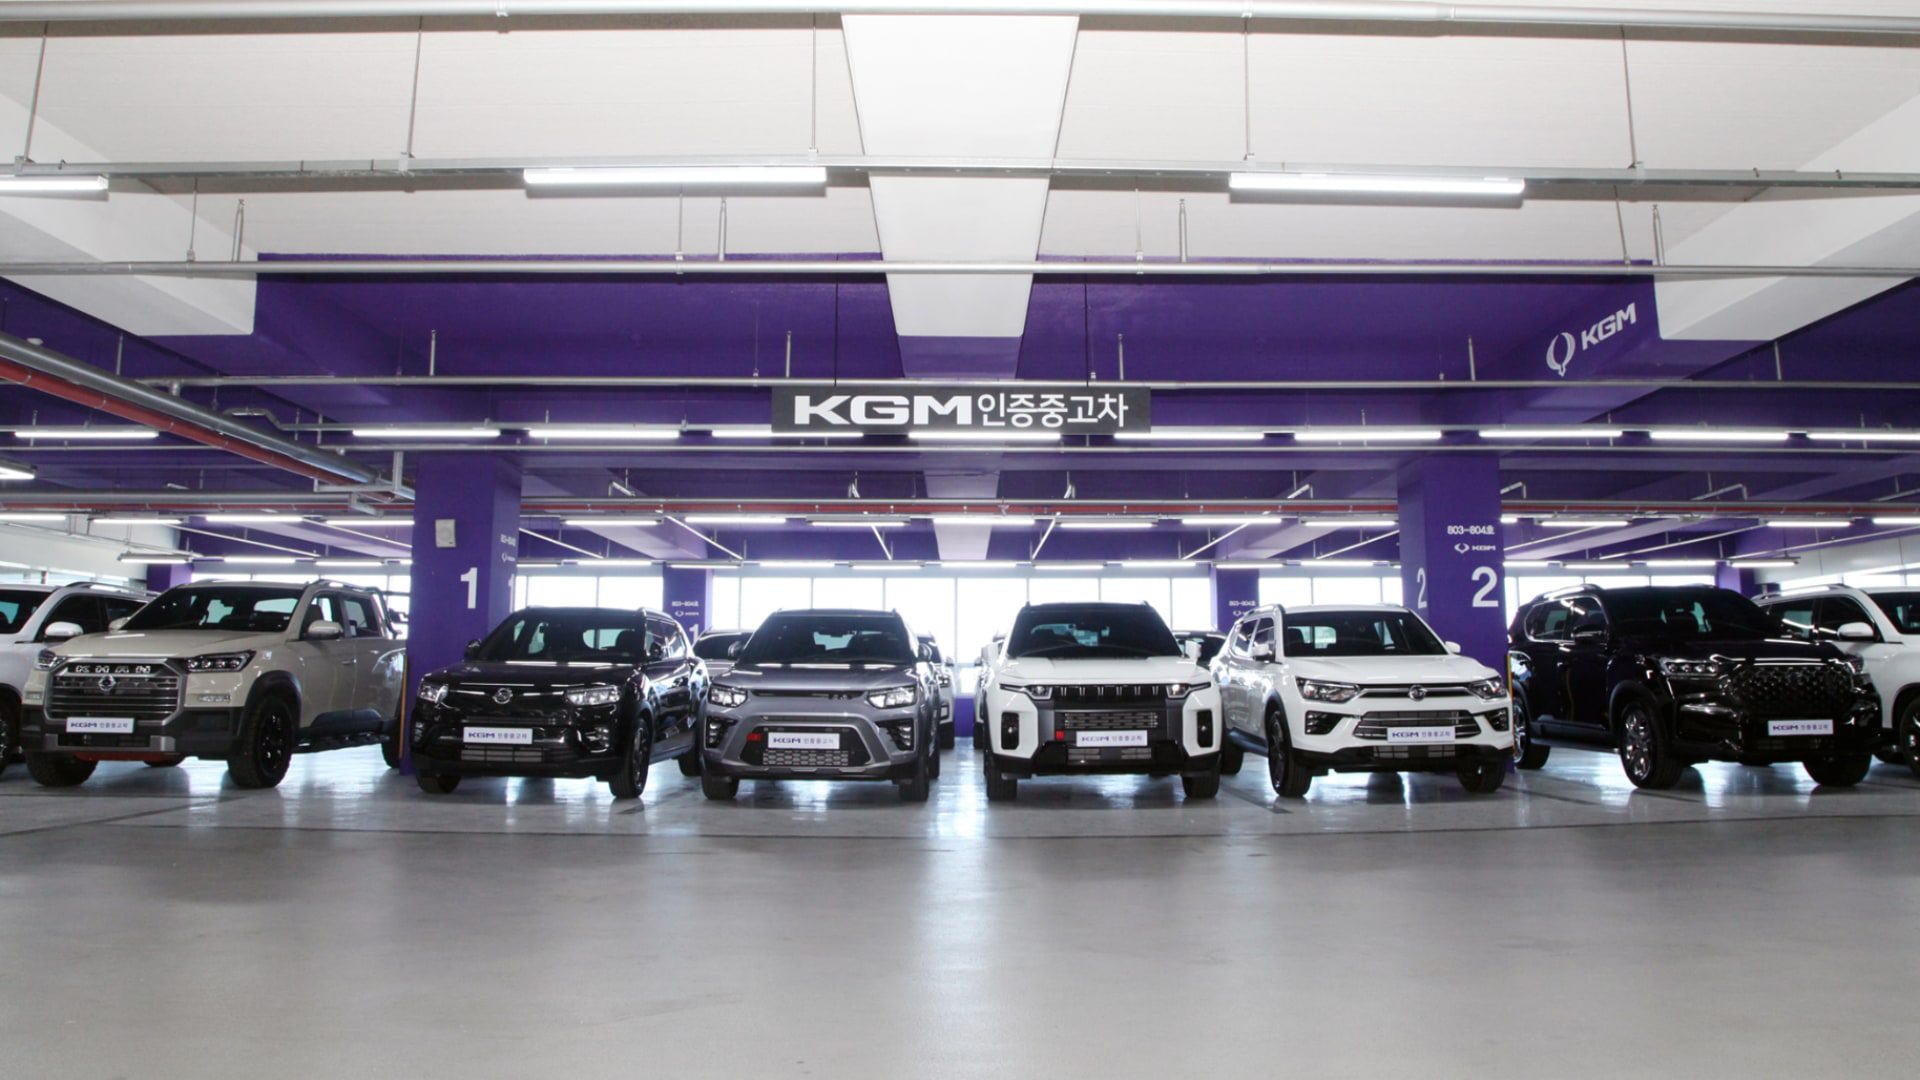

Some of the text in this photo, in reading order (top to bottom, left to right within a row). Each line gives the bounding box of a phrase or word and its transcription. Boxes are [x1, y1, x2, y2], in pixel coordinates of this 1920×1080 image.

[1581, 302, 1637, 351] KGM
[794, 393, 1129, 428] KGM 인증중고차
[460, 567, 478, 609] 1
[1417, 567, 1427, 609] 2
[1471, 566, 1499, 607] 2
[75, 665, 151, 674] KHAN
